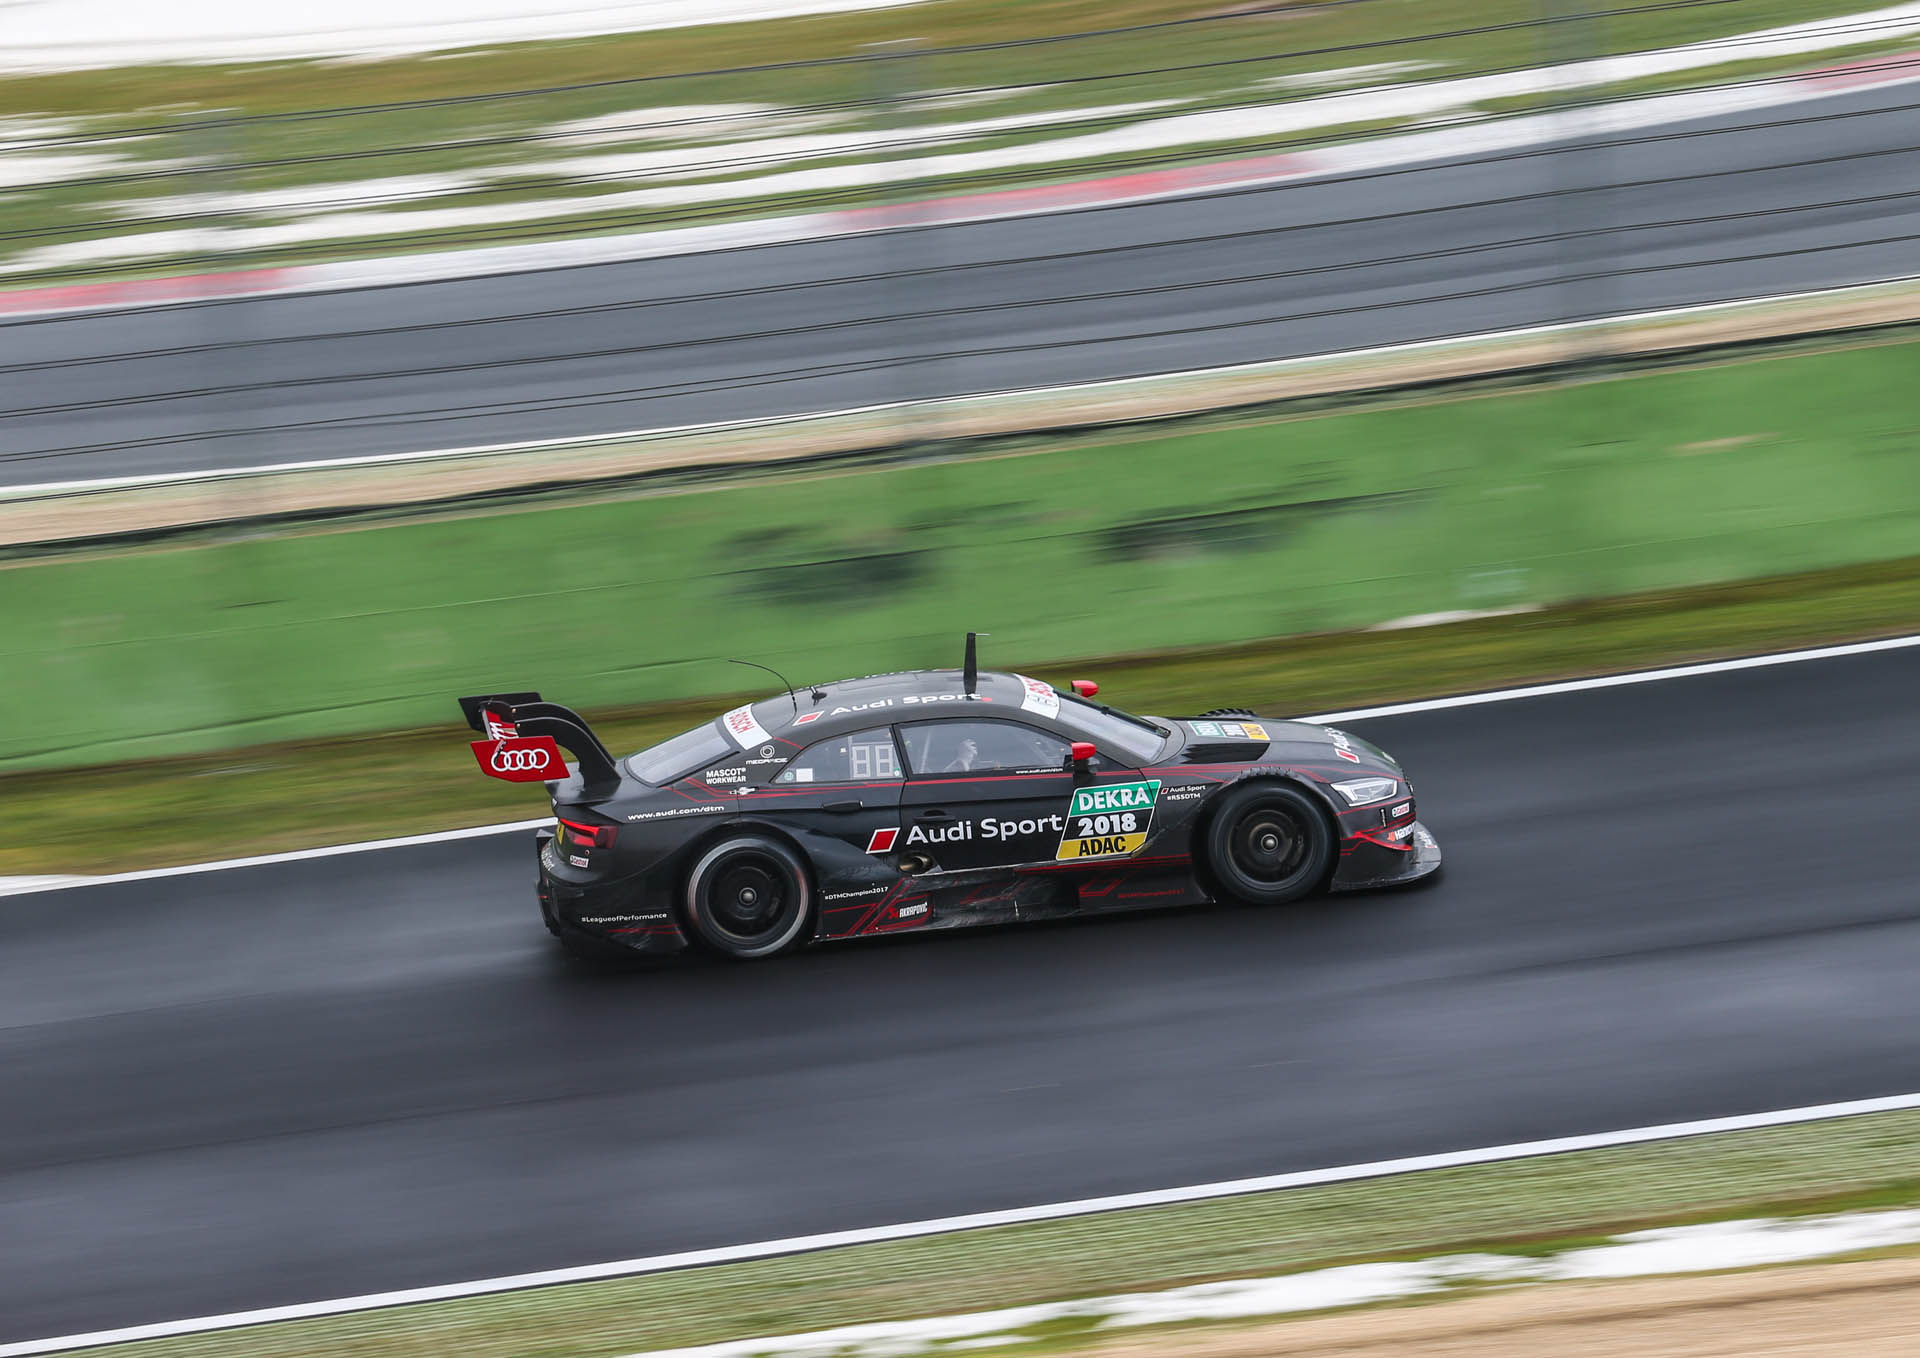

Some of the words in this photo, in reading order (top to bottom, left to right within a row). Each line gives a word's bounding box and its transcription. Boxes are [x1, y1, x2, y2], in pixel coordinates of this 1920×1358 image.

[831, 698, 893, 716] Audi
[903, 693, 981, 704] Sport
[706, 775, 747, 785] WORKWEAR
[1187, 784, 1206, 793] Sport
[1078, 787, 1151, 812] DEKRA
[627, 804, 725, 821] www.audi.com/dtm
[906, 820, 973, 846] Audi
[980, 813, 1064, 842] Sport
[1078, 812, 1138, 837] 2018
[1078, 835, 1127, 857] ADAC
[824, 886, 889, 900] #DTMChampion2017
[581, 912, 668, 924] #LeagueofPerformance
